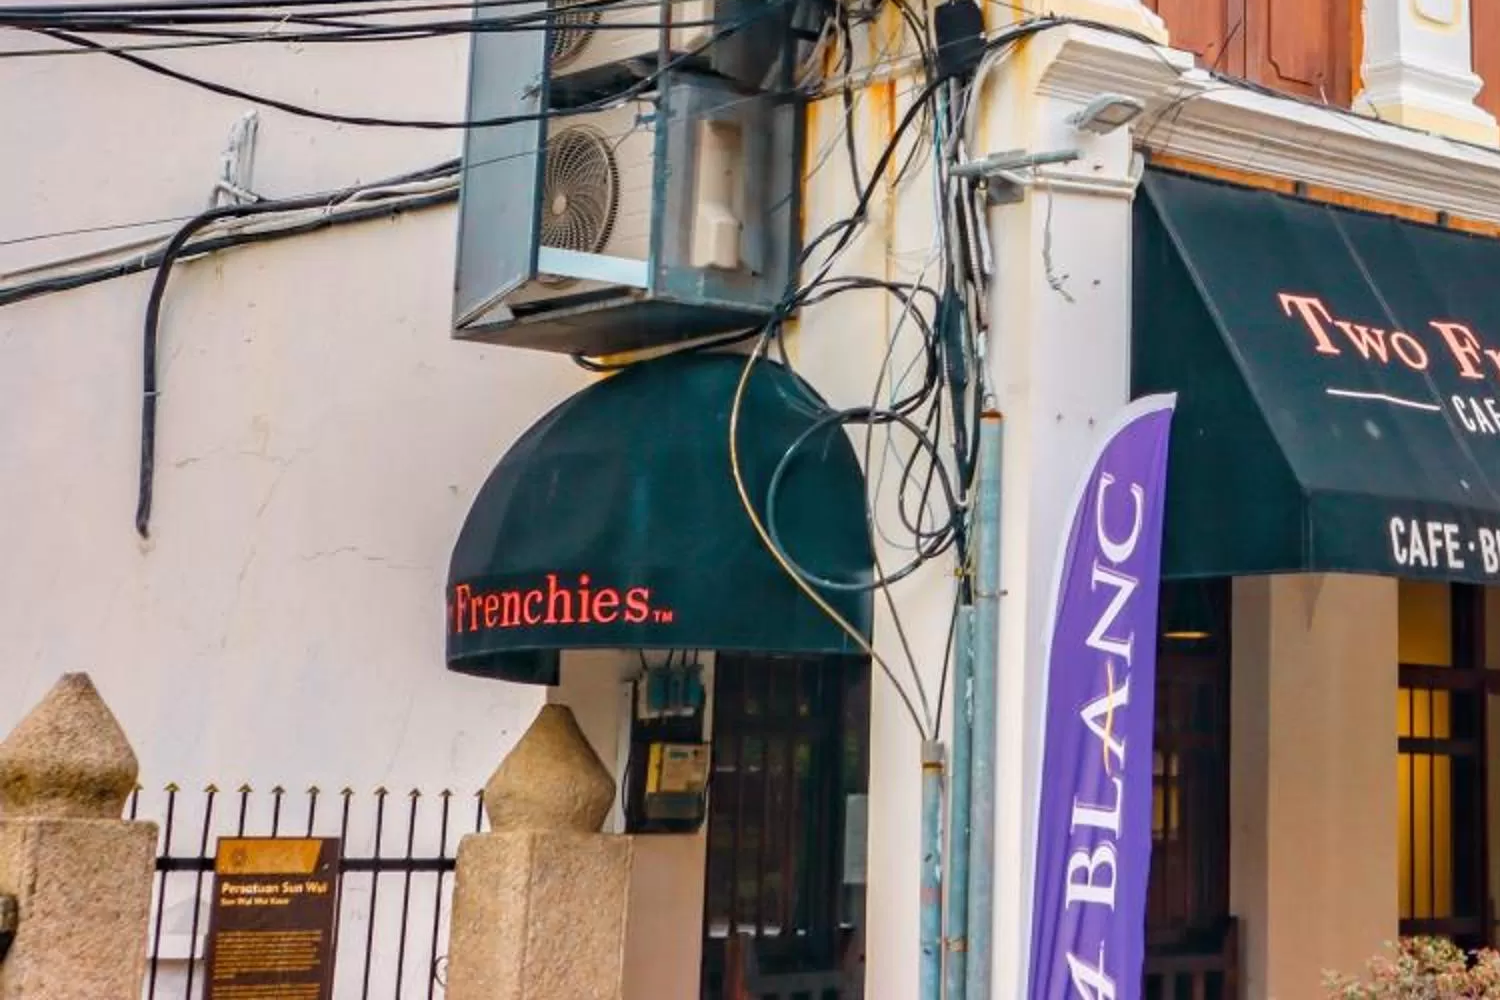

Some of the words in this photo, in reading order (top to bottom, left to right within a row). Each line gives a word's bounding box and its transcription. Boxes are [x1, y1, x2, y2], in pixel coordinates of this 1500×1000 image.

[1279, 293, 1429, 371] Two
[1389, 516, 1465, 570] CAFE
[455, 571, 650, 633] Frenchies
[1066, 470, 1145, 911] BLANC
[221, 881, 280, 895] Persatuan
[282, 881, 303, 894] Sun
